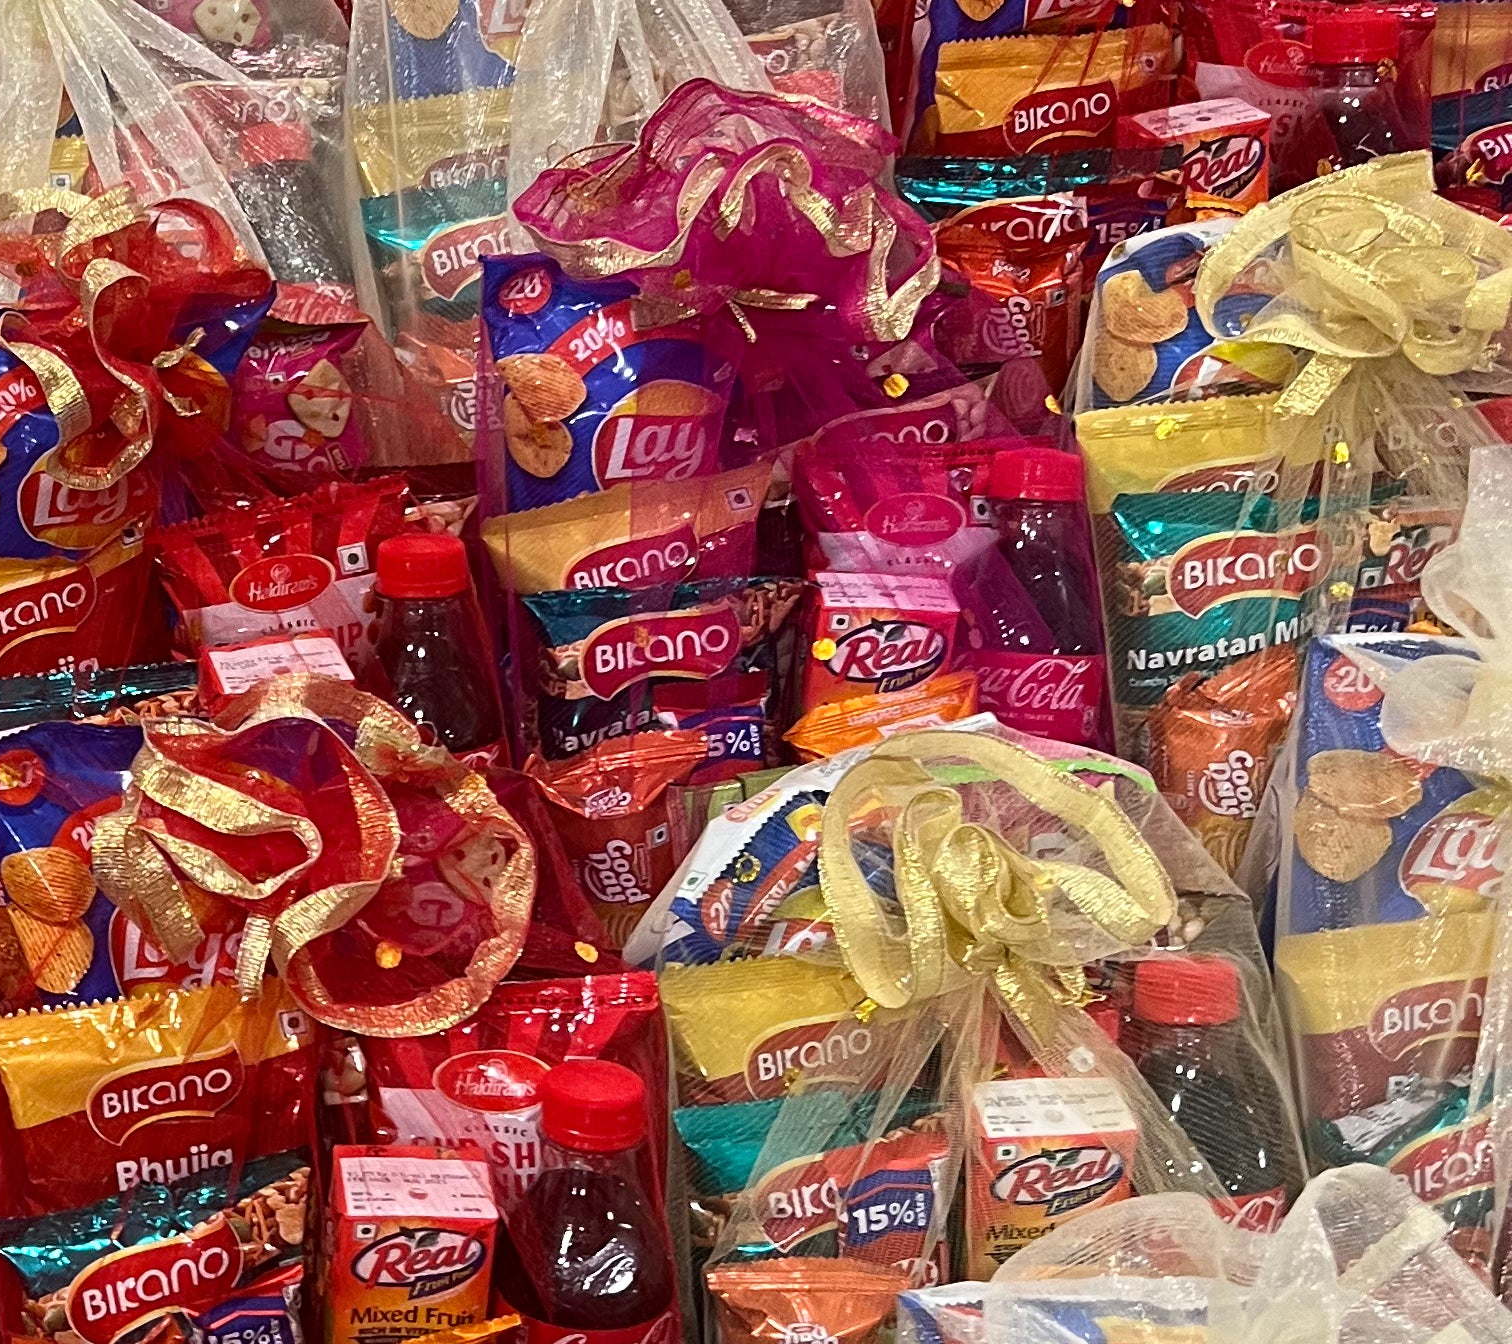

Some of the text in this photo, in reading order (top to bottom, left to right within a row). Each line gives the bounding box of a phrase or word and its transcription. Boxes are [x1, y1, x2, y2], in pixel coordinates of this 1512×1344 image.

[846, 630, 947, 679] Real
[1127, 632, 1266, 672] Navratan
[1011, 1153, 1112, 1207] Real
[851, 1201, 914, 1235] 15%
[368, 1230, 486, 1285] Real
[350, 1304, 478, 1326] Mixed Fruit
